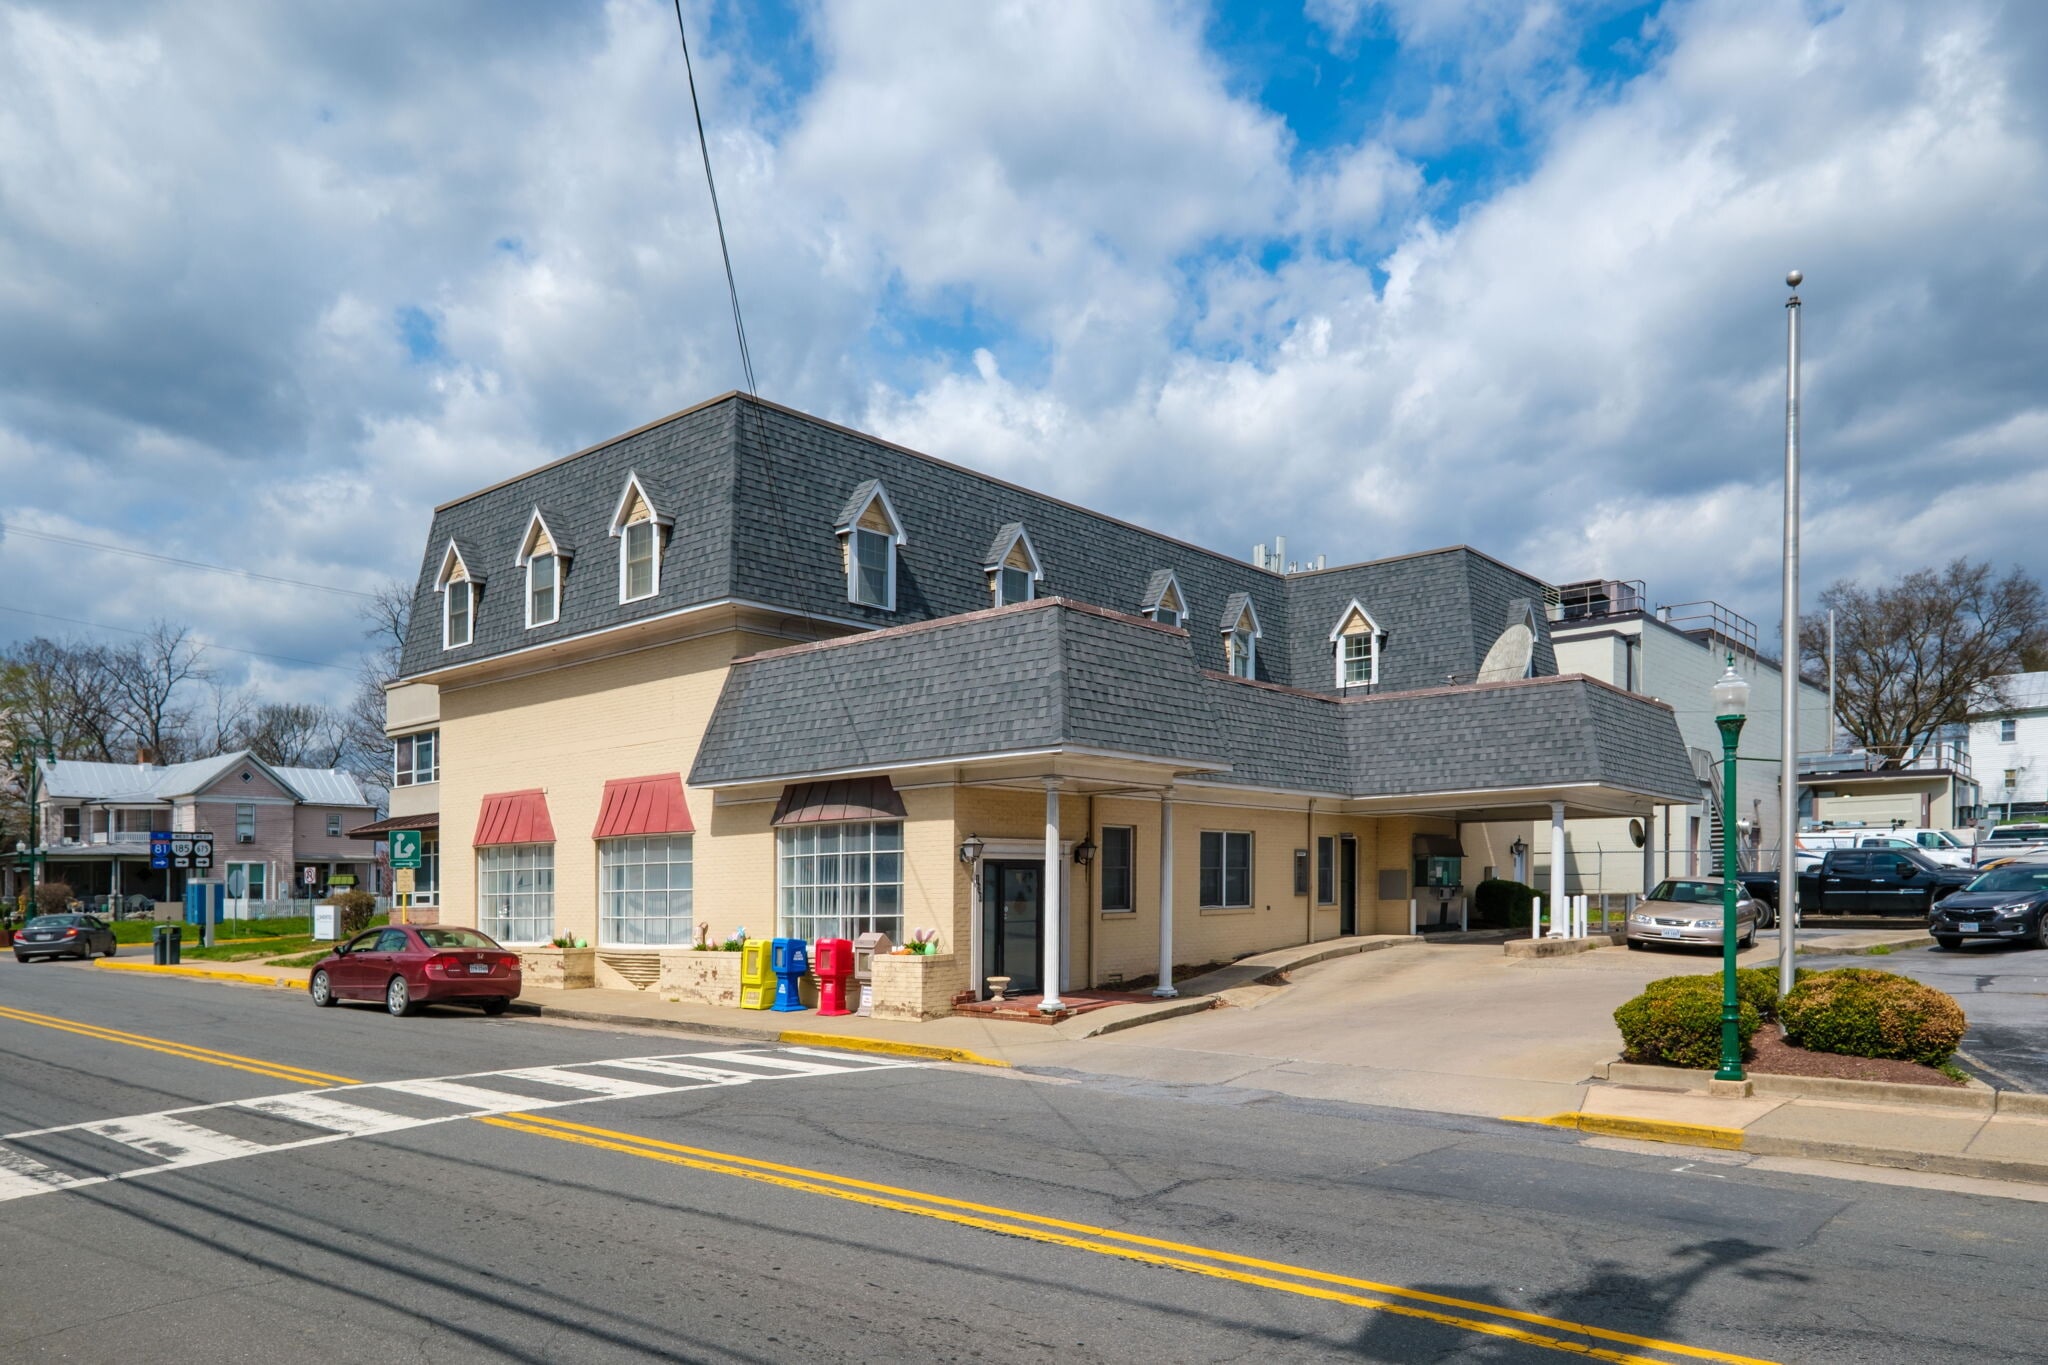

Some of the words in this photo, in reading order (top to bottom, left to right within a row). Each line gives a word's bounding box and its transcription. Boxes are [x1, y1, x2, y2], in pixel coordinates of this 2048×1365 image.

[154, 844, 167, 854] 81
[175, 844, 190, 853] 185
[196, 845, 209, 853] 675
